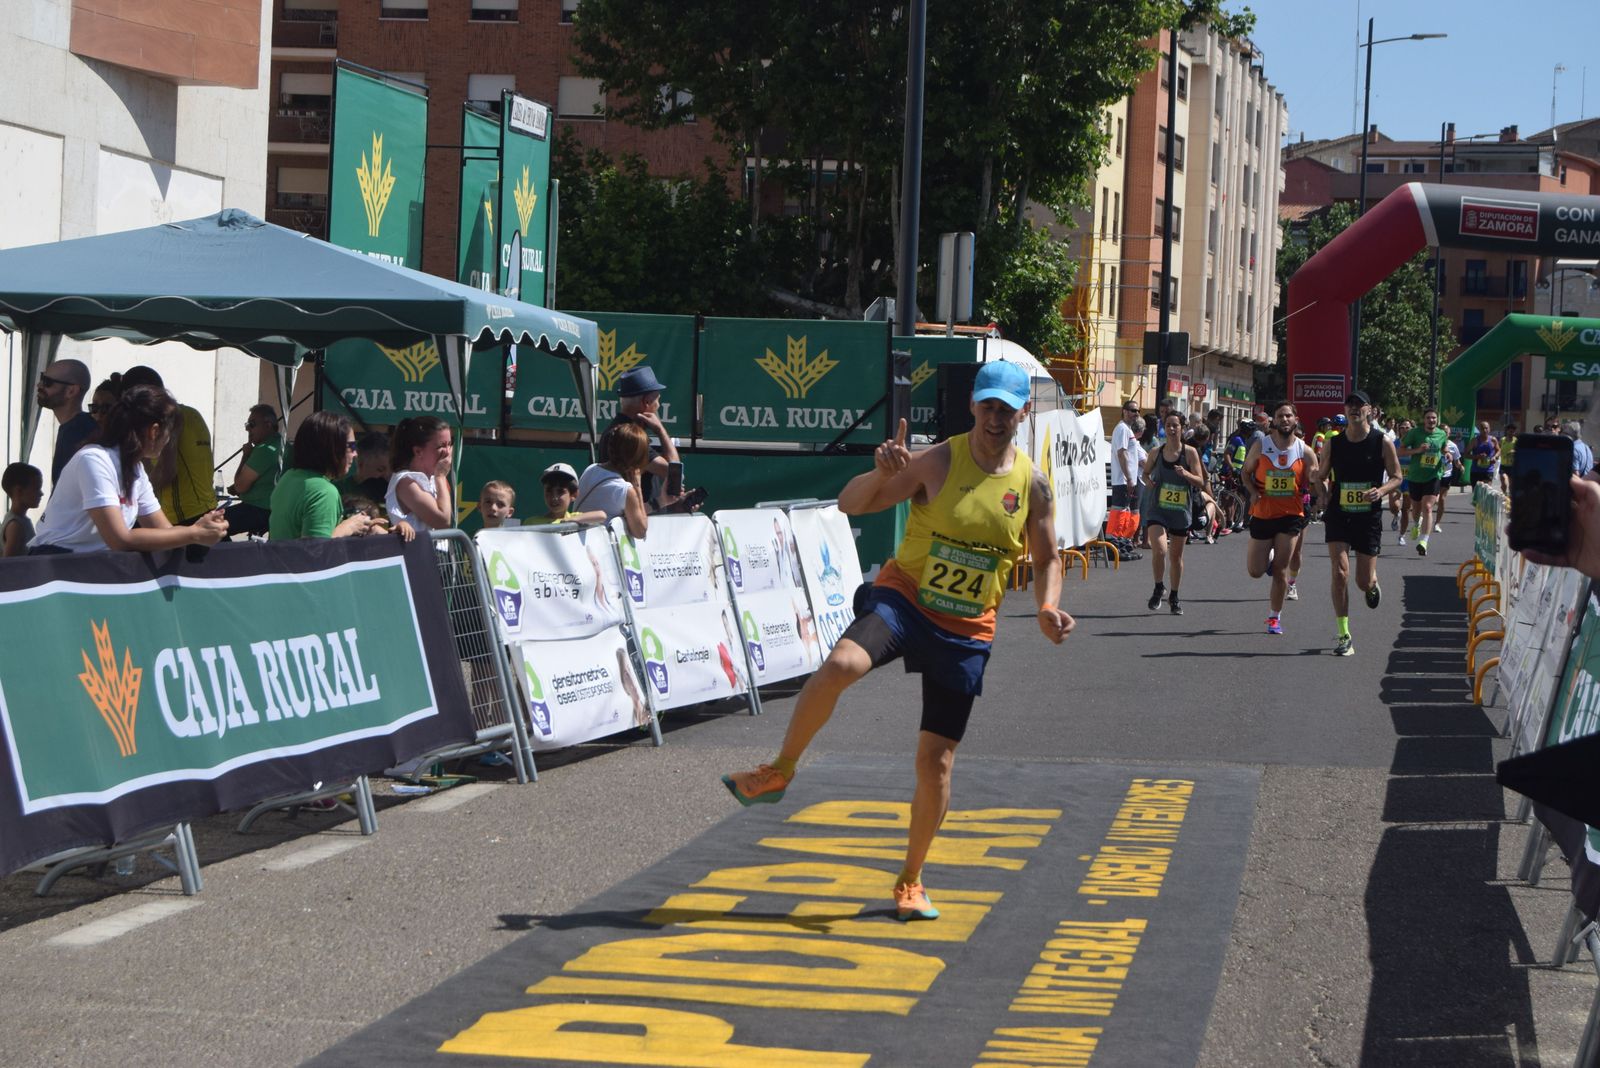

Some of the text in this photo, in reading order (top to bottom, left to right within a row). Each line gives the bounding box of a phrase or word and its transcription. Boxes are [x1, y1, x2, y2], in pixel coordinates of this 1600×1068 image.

[1480, 212, 1522, 222] DIPUTACIÓN
[1556, 206, 1594, 222] CON
[1479, 220, 1533, 234] ZAMORA
[522, 248, 544, 272] RURAL
[340, 388, 396, 410] CAJA
[1304, 390, 1342, 398] ZAMORA
[528, 396, 586, 418] CAJA
[720, 406, 872, 430] CAJA RURAL
[1272, 478, 1288, 490] 35
[1166, 490, 1180, 503] 23
[1346, 490, 1364, 504] 68
[928, 562, 984, 599] 224
[936, 598, 978, 614] CAJA RURAL
[154, 628, 380, 738] CAJA RURAL
[1105, 778, 1195, 842] INTERIORES
[1078, 846, 1173, 897] DISEÑO
[1008, 918, 1148, 1016] INTEGRAL
